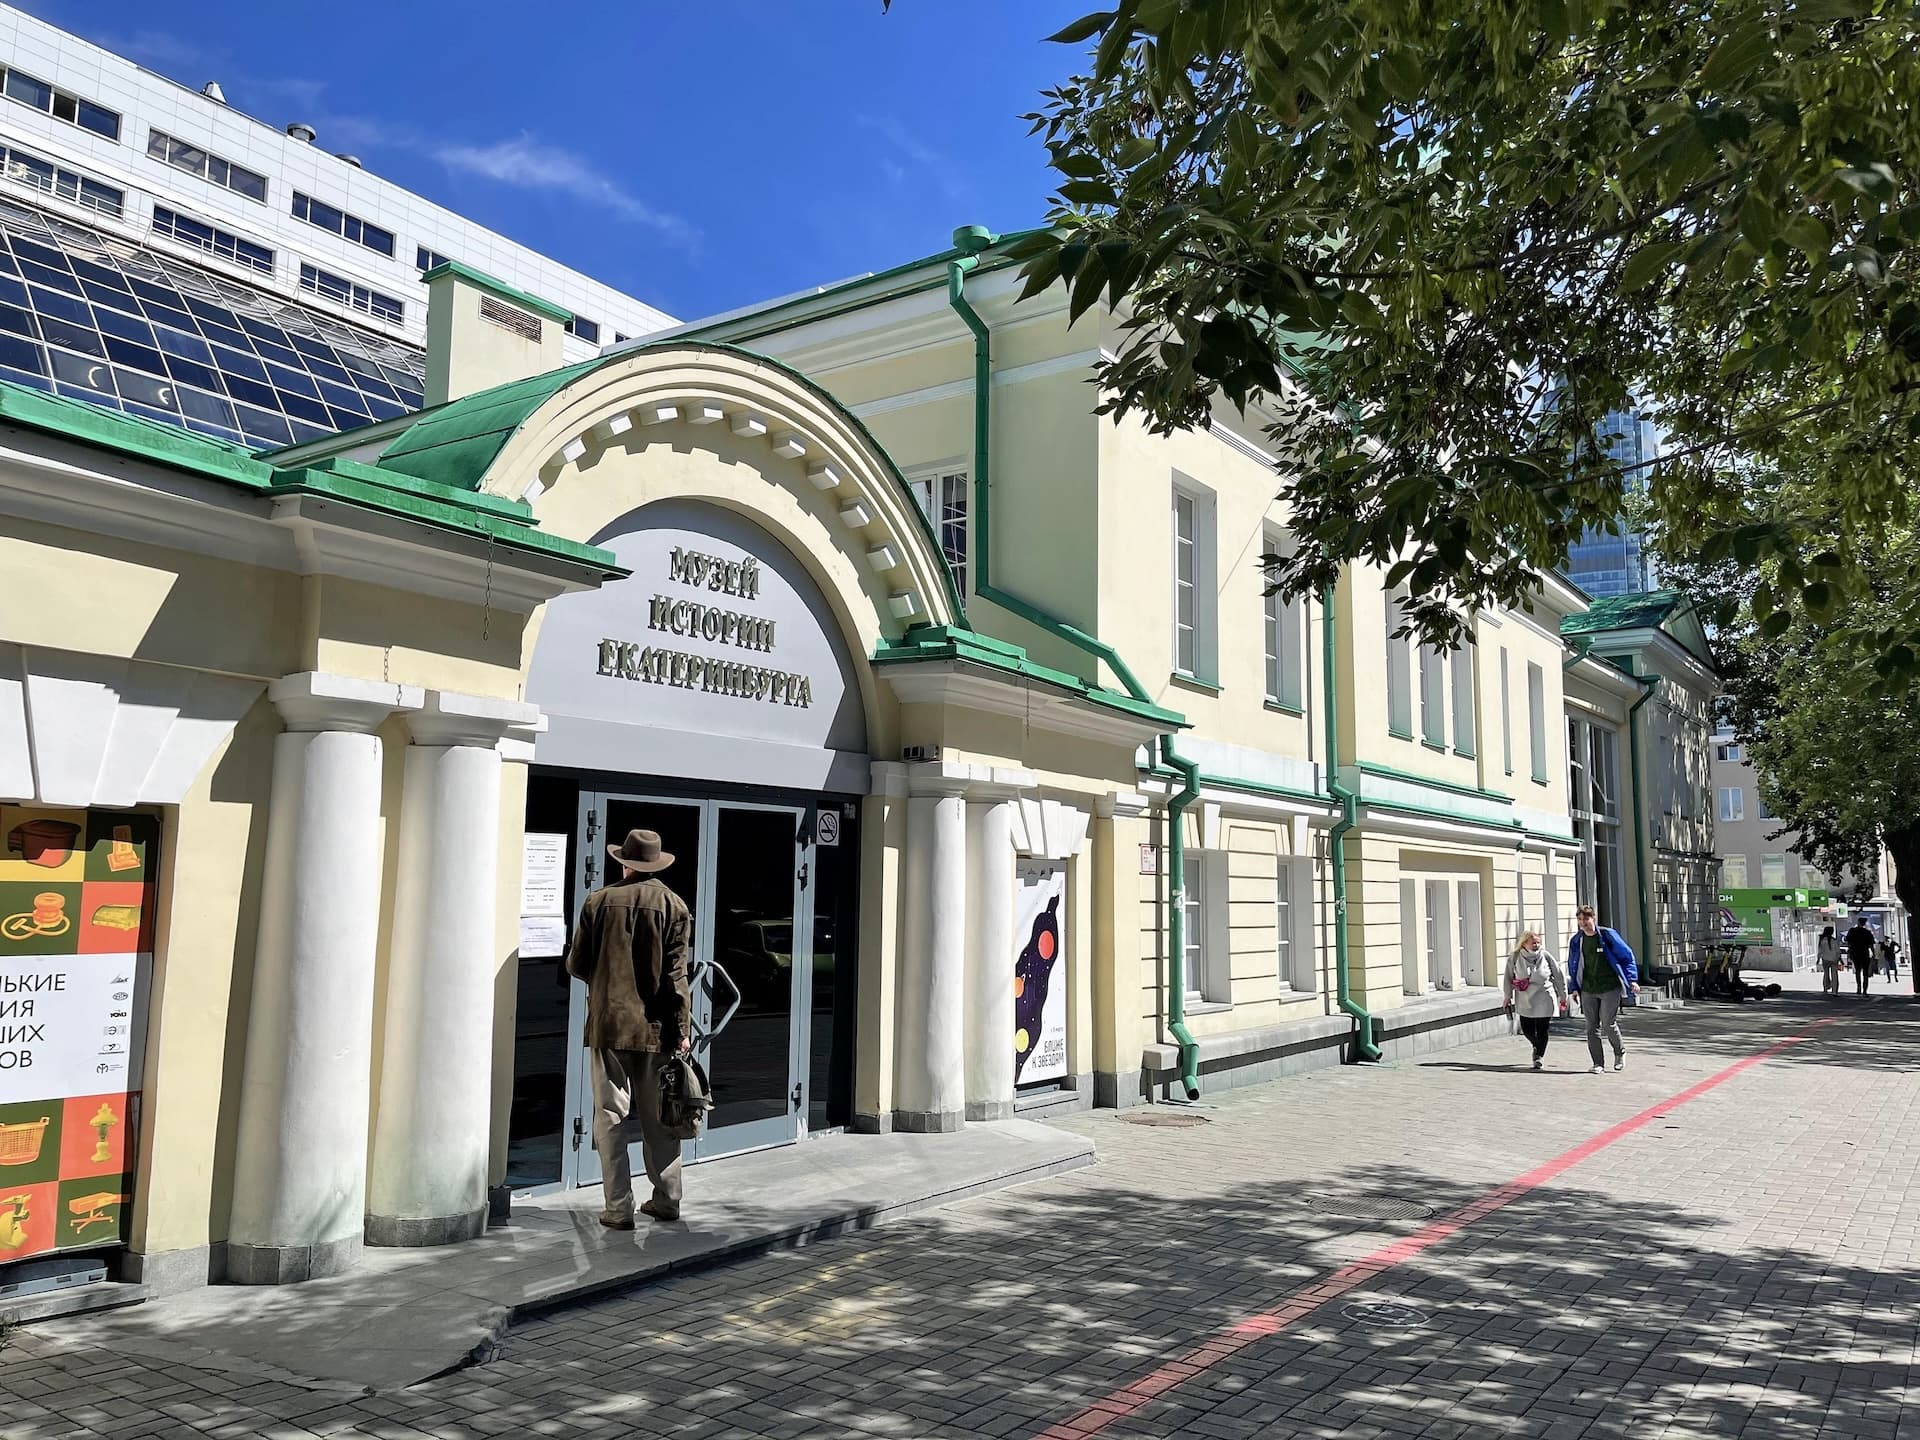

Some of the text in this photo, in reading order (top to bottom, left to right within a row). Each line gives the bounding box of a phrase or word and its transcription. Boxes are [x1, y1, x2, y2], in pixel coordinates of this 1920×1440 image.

[669, 546, 761, 600] МУЗЕЙ
[648, 593, 776, 653] ИСТОРИИ
[596, 638, 814, 709] ЕКАТЕРИНБУРГА
[0, 973, 66, 993] ЬКИЕ
